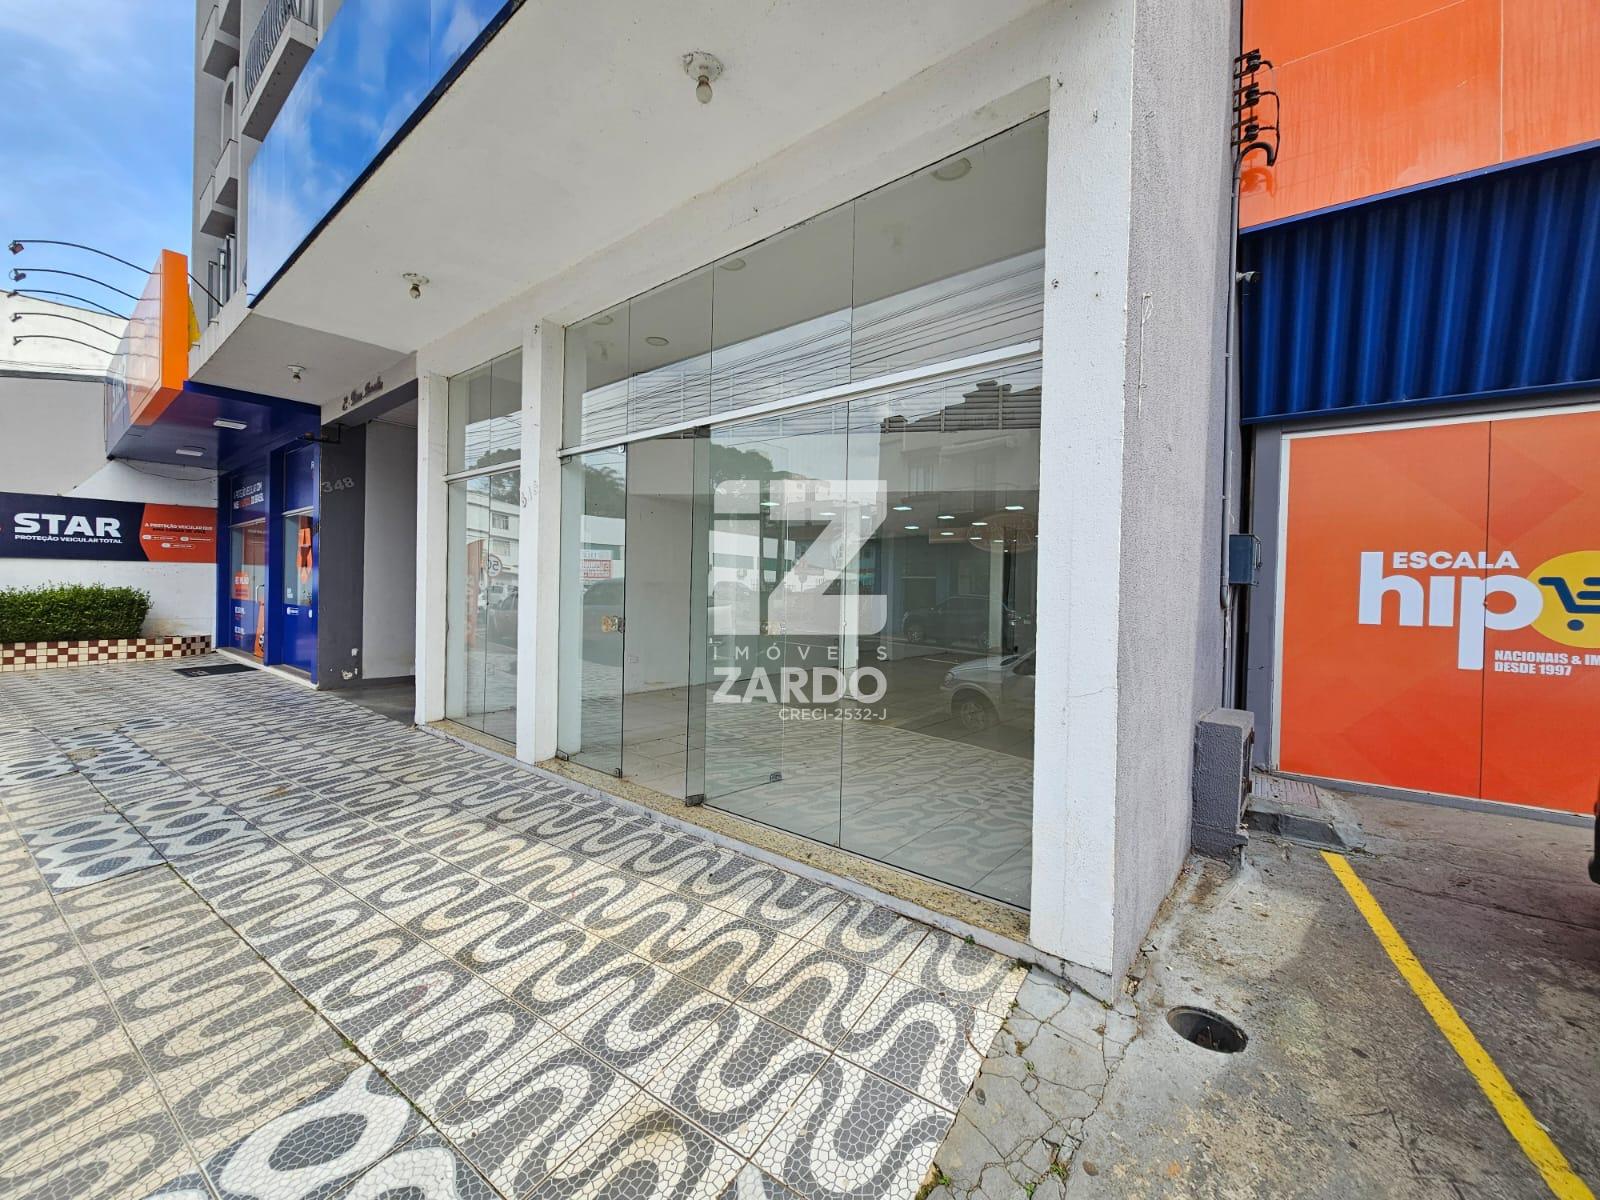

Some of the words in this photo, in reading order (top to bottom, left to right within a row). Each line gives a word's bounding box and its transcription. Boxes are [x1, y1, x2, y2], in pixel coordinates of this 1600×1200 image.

[322, 476, 355, 493] 348
[14, 512, 122, 538] STAR
[14, 534, 59, 543] PROTEÇÃO
[60, 536, 98, 544] VEICULAR
[1392, 551, 1520, 569] ESCALA
[1494, 650, 1568, 664] NACIONAIS
[1571, 655, 1582, 665] &
[1494, 661, 1536, 674] DESDE
[1538, 664, 1572, 676] 1997
